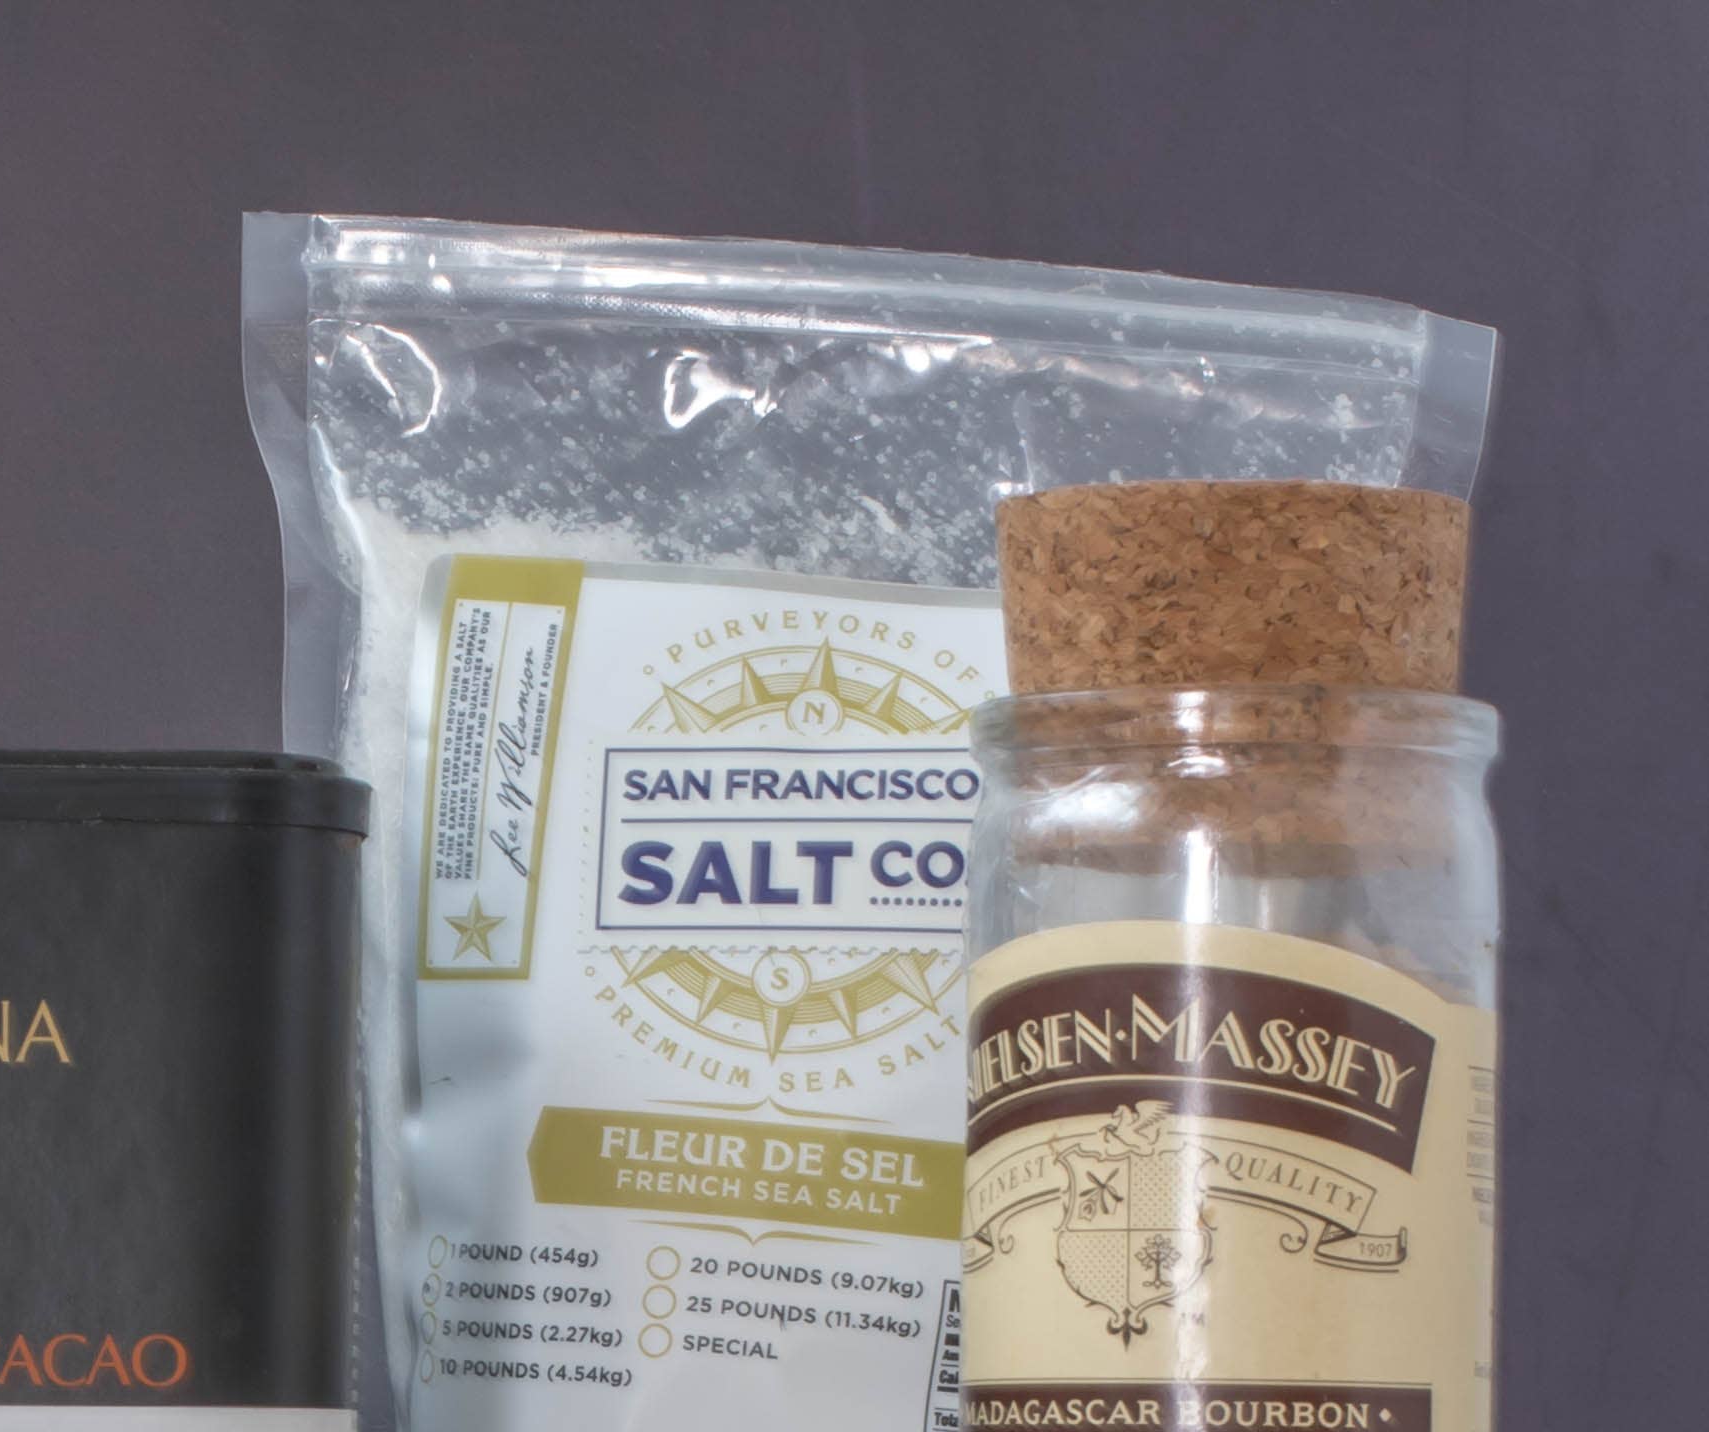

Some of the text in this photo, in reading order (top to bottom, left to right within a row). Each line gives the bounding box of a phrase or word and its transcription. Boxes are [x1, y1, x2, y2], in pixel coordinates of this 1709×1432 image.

[666, 610, 979, 684] PURVEYORS OF
[446, 667, 461, 731] PROVIDING
[802, 701, 825, 725] N
[623, 768, 979, 802] SAN FRANCISCO
[618, 840, 854, 906] SALT
[770, 967, 790, 991] S
[594, 985, 963, 1093] PREMIUM SEA SALT
[600, 1126, 925, 1188] FLEUR DE SEL
[617, 1169, 902, 1215] FRENCH SEA SALT
[459, 1243, 599, 1268] POUND (454g)
[459, 1282, 612, 1308] POUNDS (907g)
[690, 1257, 925, 1299] 20 POUNDS (9.07kg)
[457, 1321, 623, 1348] POUNDS (2.27kg)
[686, 1296, 921, 1338] 25 POUNDS (11.34kg)
[682, 1335, 779, 1360] SPECIAL
[463, 1360, 633, 1387] POUNDS (4.54kg)
